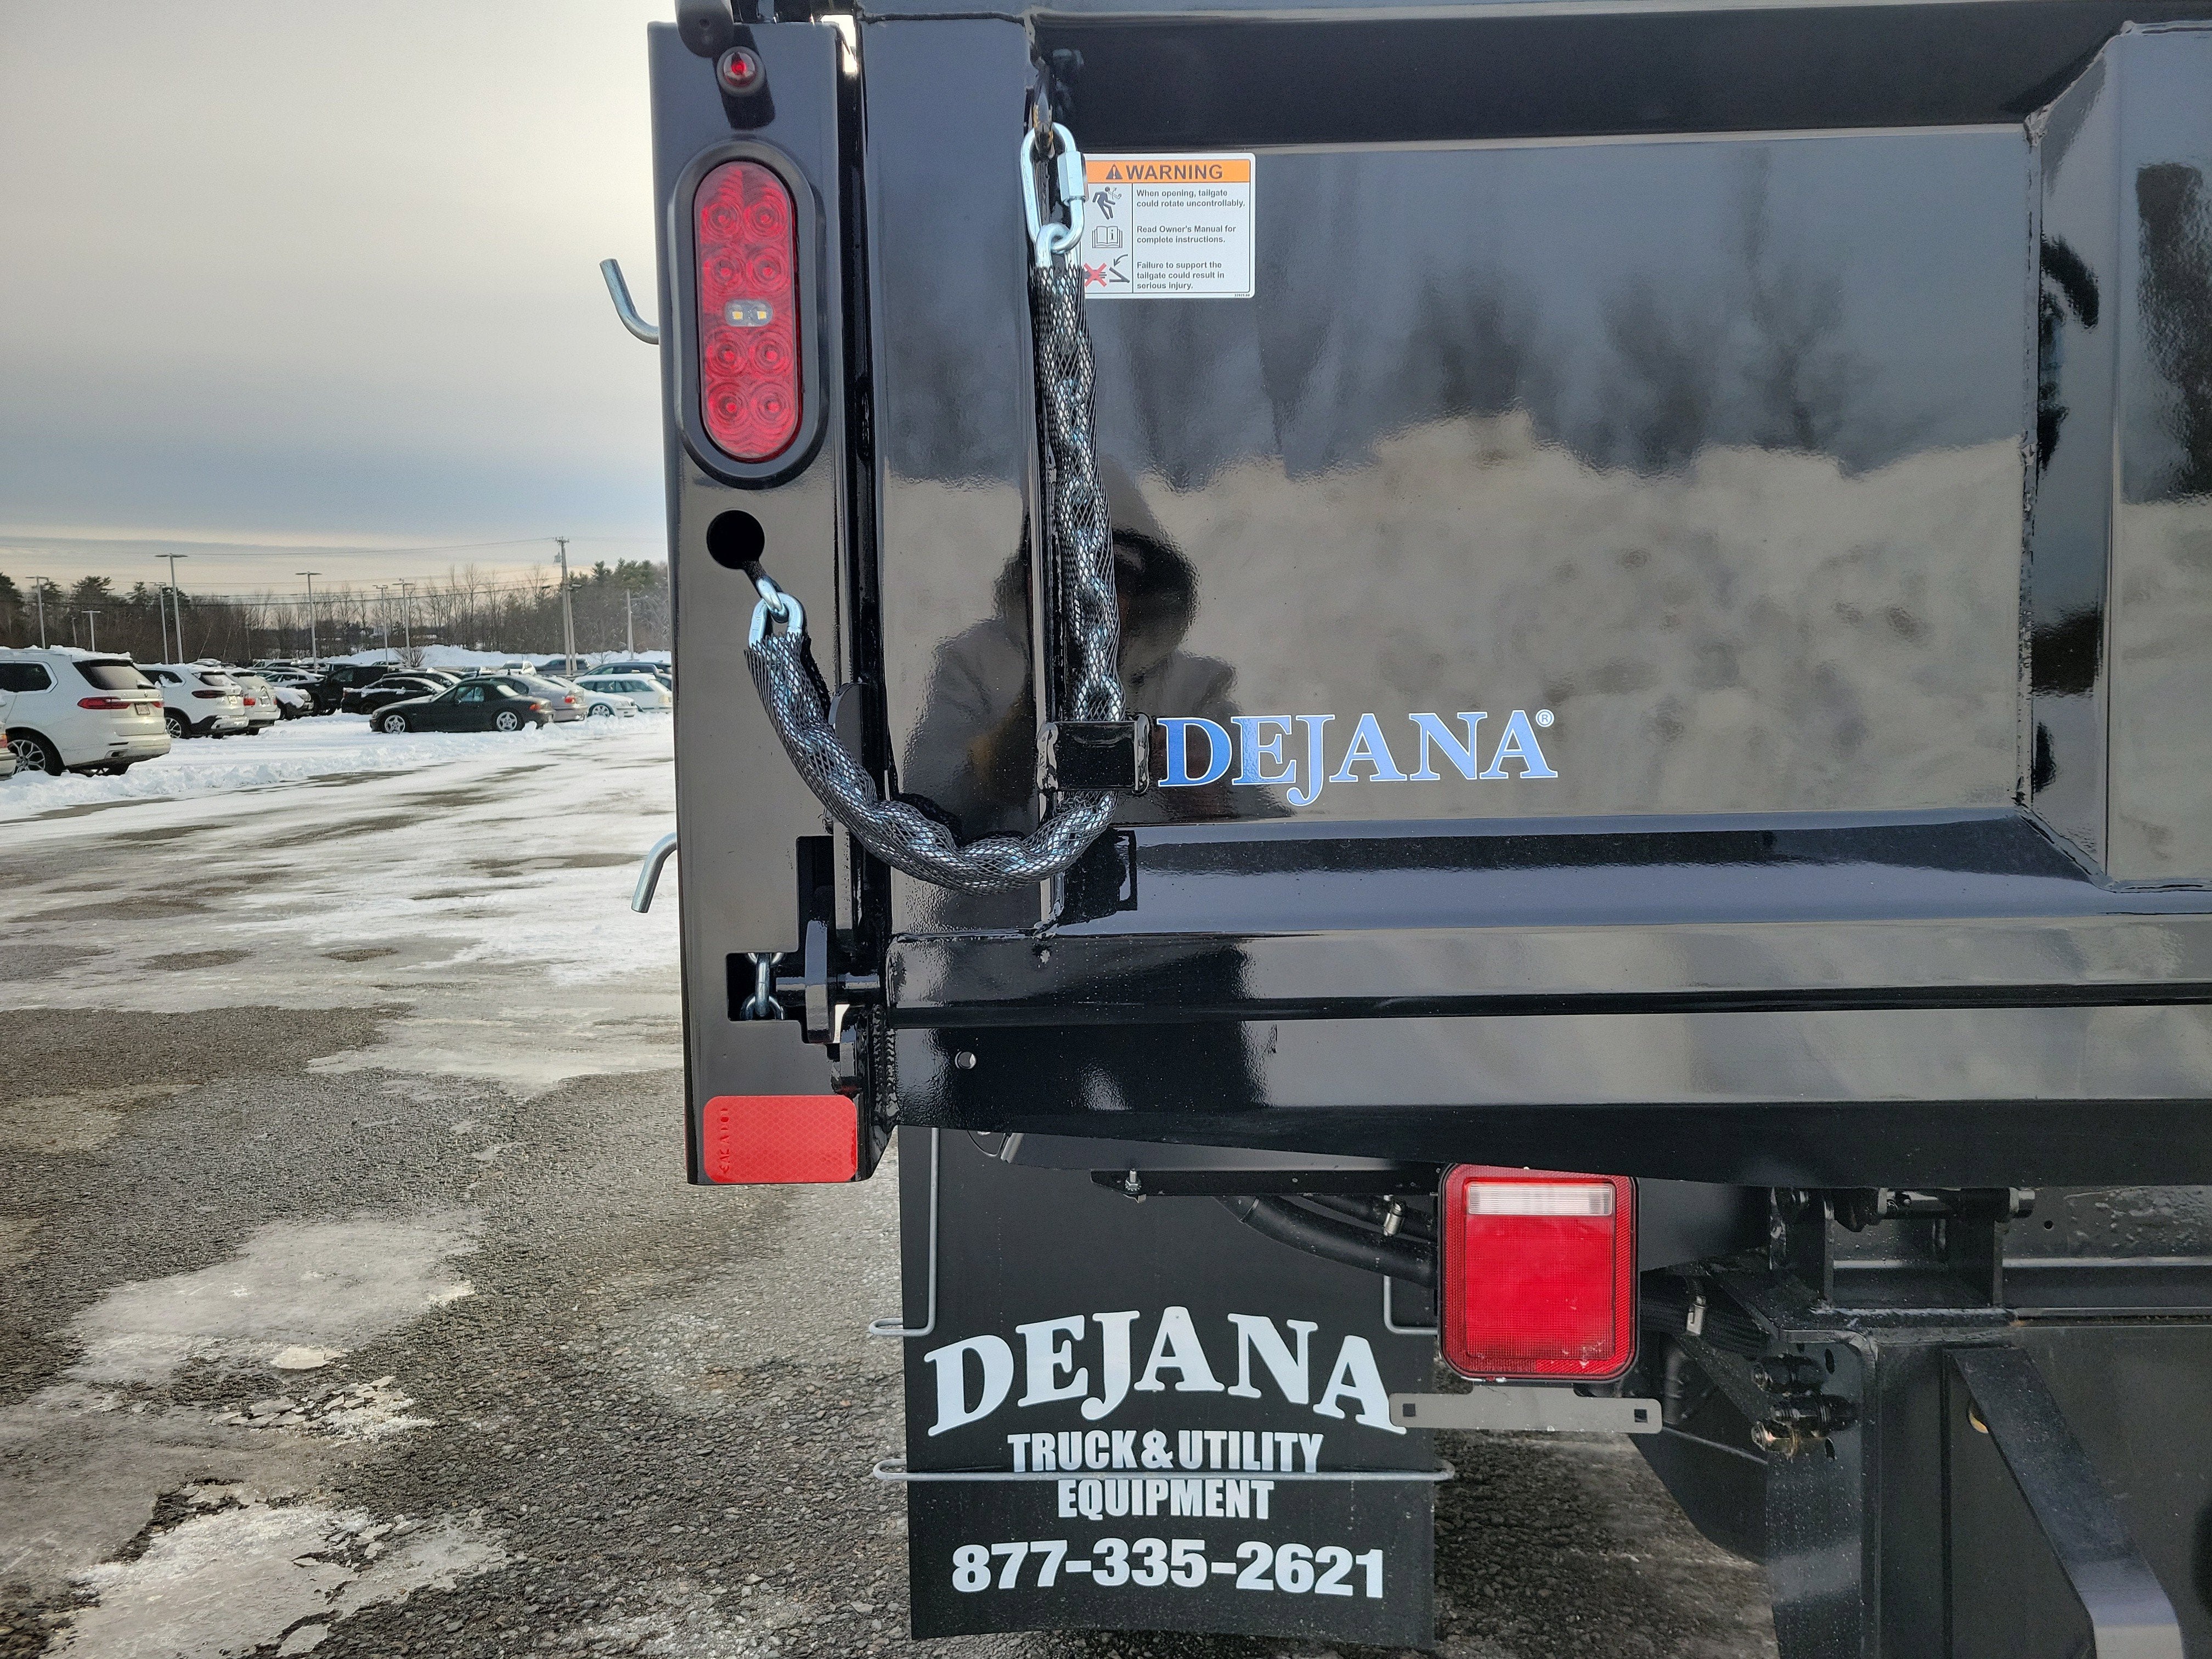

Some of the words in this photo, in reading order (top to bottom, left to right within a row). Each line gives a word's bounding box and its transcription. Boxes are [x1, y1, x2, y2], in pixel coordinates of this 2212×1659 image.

[1126, 165, 1222, 180] WARNING
[1161, 189, 1196, 198] opening,
[1198, 189, 1228, 198] tailgate
[1186, 199, 1245, 208] uncontrollably.
[1137, 235, 1173, 244] complete
[1176, 261, 1207, 270] support
[1137, 272, 1166, 280] tailgate
[1169, 281, 1193, 290] injury.
[923, 1306, 1407, 1437] DEJANA
[1058, 1479, 1274, 1521] EQUIPMENT
[952, 1538, 1384, 1599] 877-335-2621
